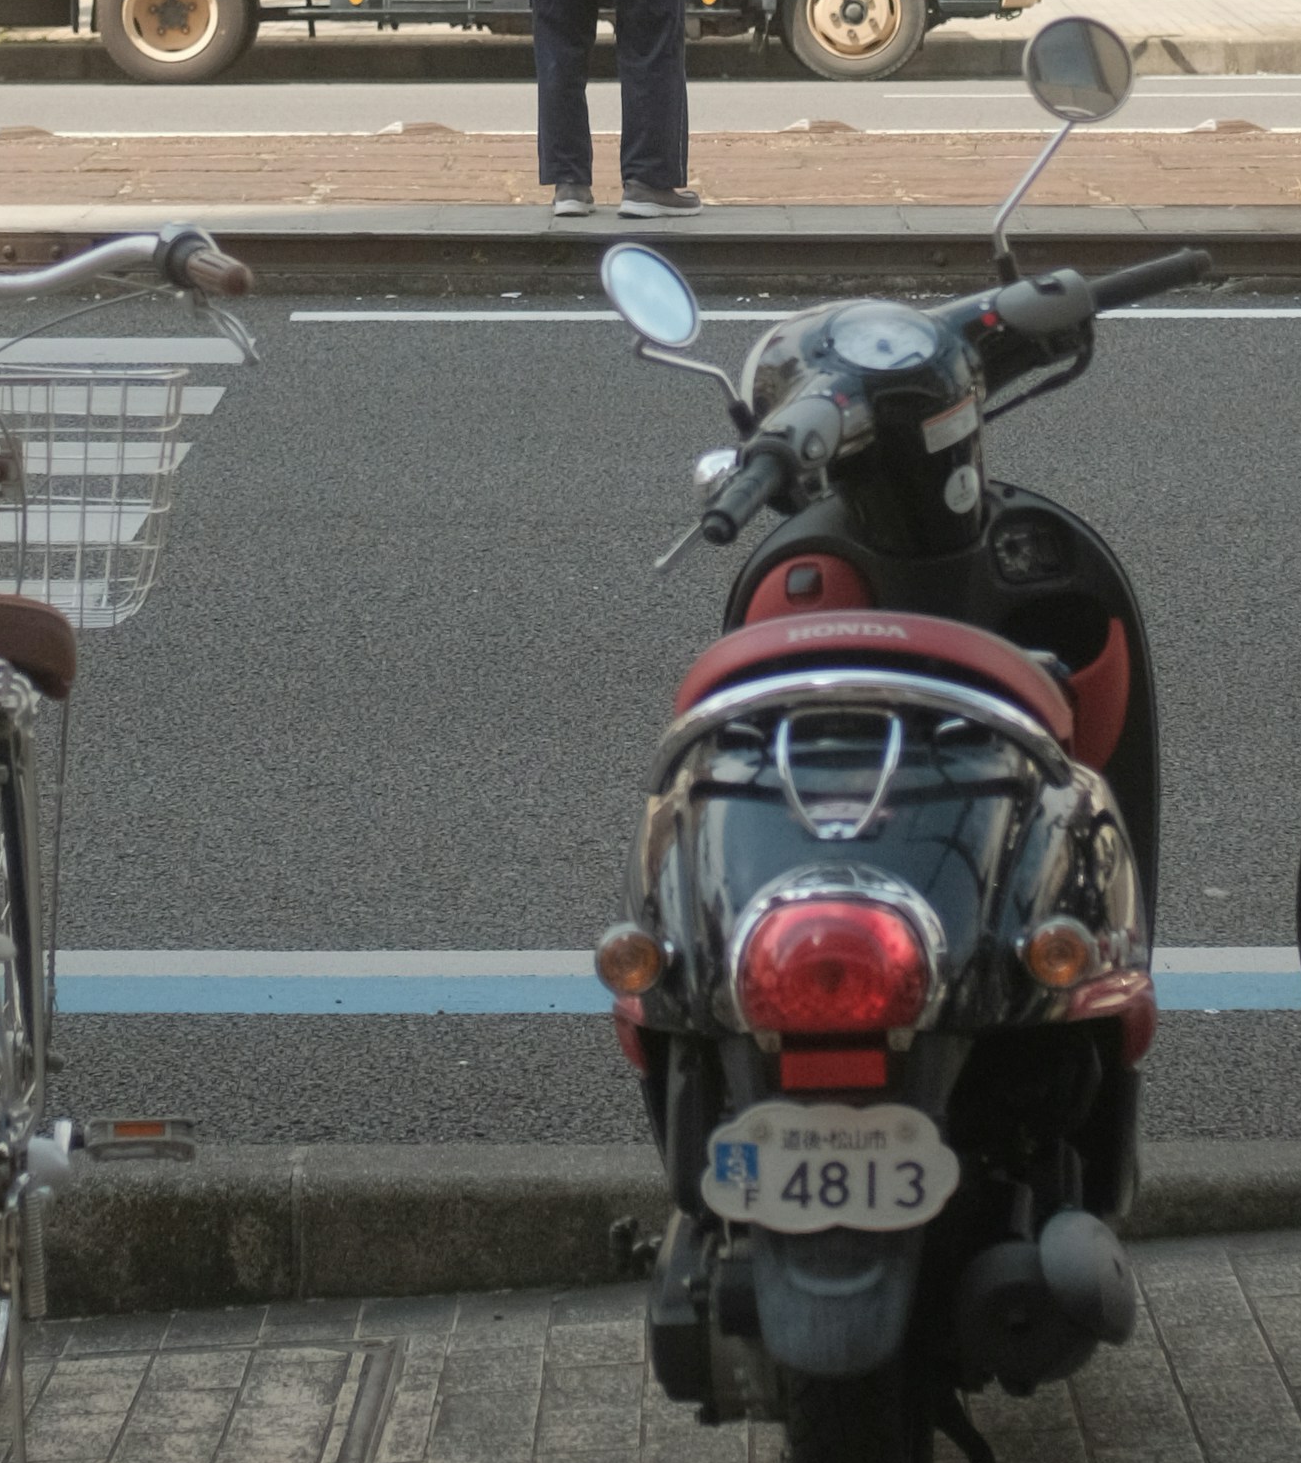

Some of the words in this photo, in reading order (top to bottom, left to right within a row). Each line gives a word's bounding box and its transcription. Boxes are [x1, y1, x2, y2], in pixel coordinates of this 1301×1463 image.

[788, 623, 908, 642] HONDA
[781, 1160, 925, 1210] 4813
[744, 1187, 760, 1210] F
